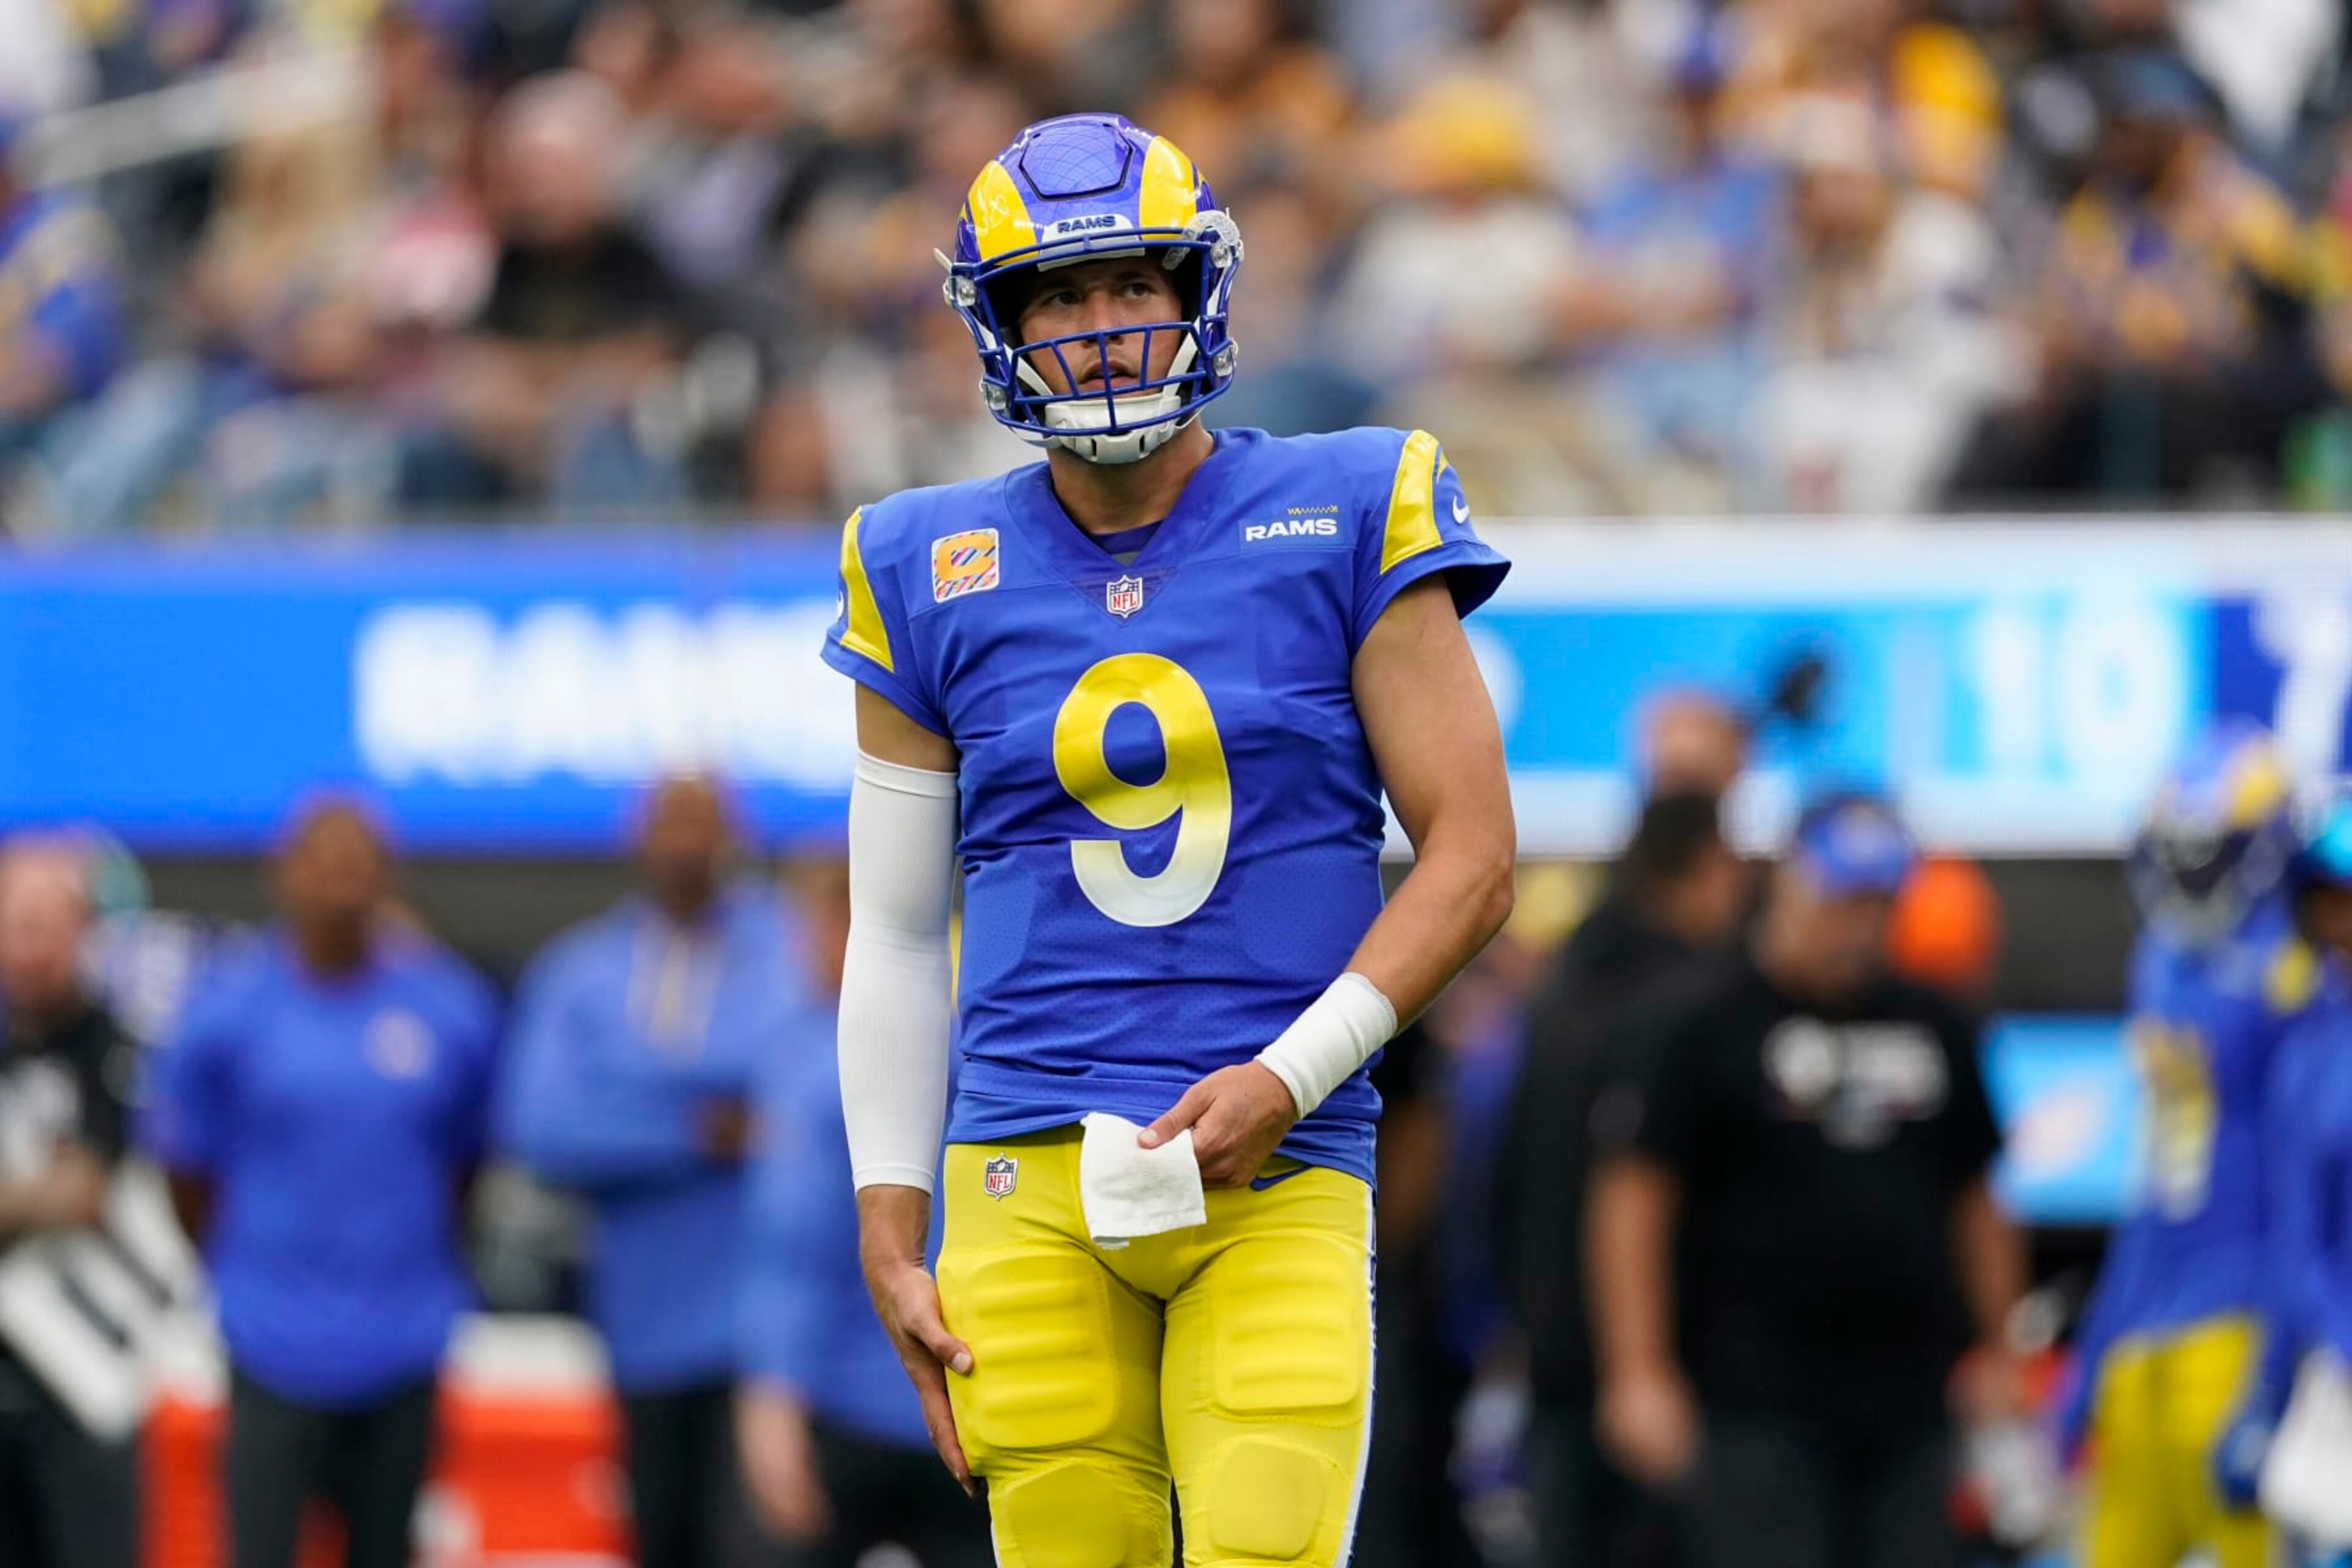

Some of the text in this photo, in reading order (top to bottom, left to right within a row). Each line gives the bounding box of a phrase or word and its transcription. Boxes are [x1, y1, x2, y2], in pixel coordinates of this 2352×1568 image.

[1057, 215, 1115, 233] RAMS
[1245, 518, 1338, 542] RAMS
[1112, 592, 1137, 609] NFL
[1052, 652, 1232, 927] 9
[989, 1174, 1010, 1191] NFL
